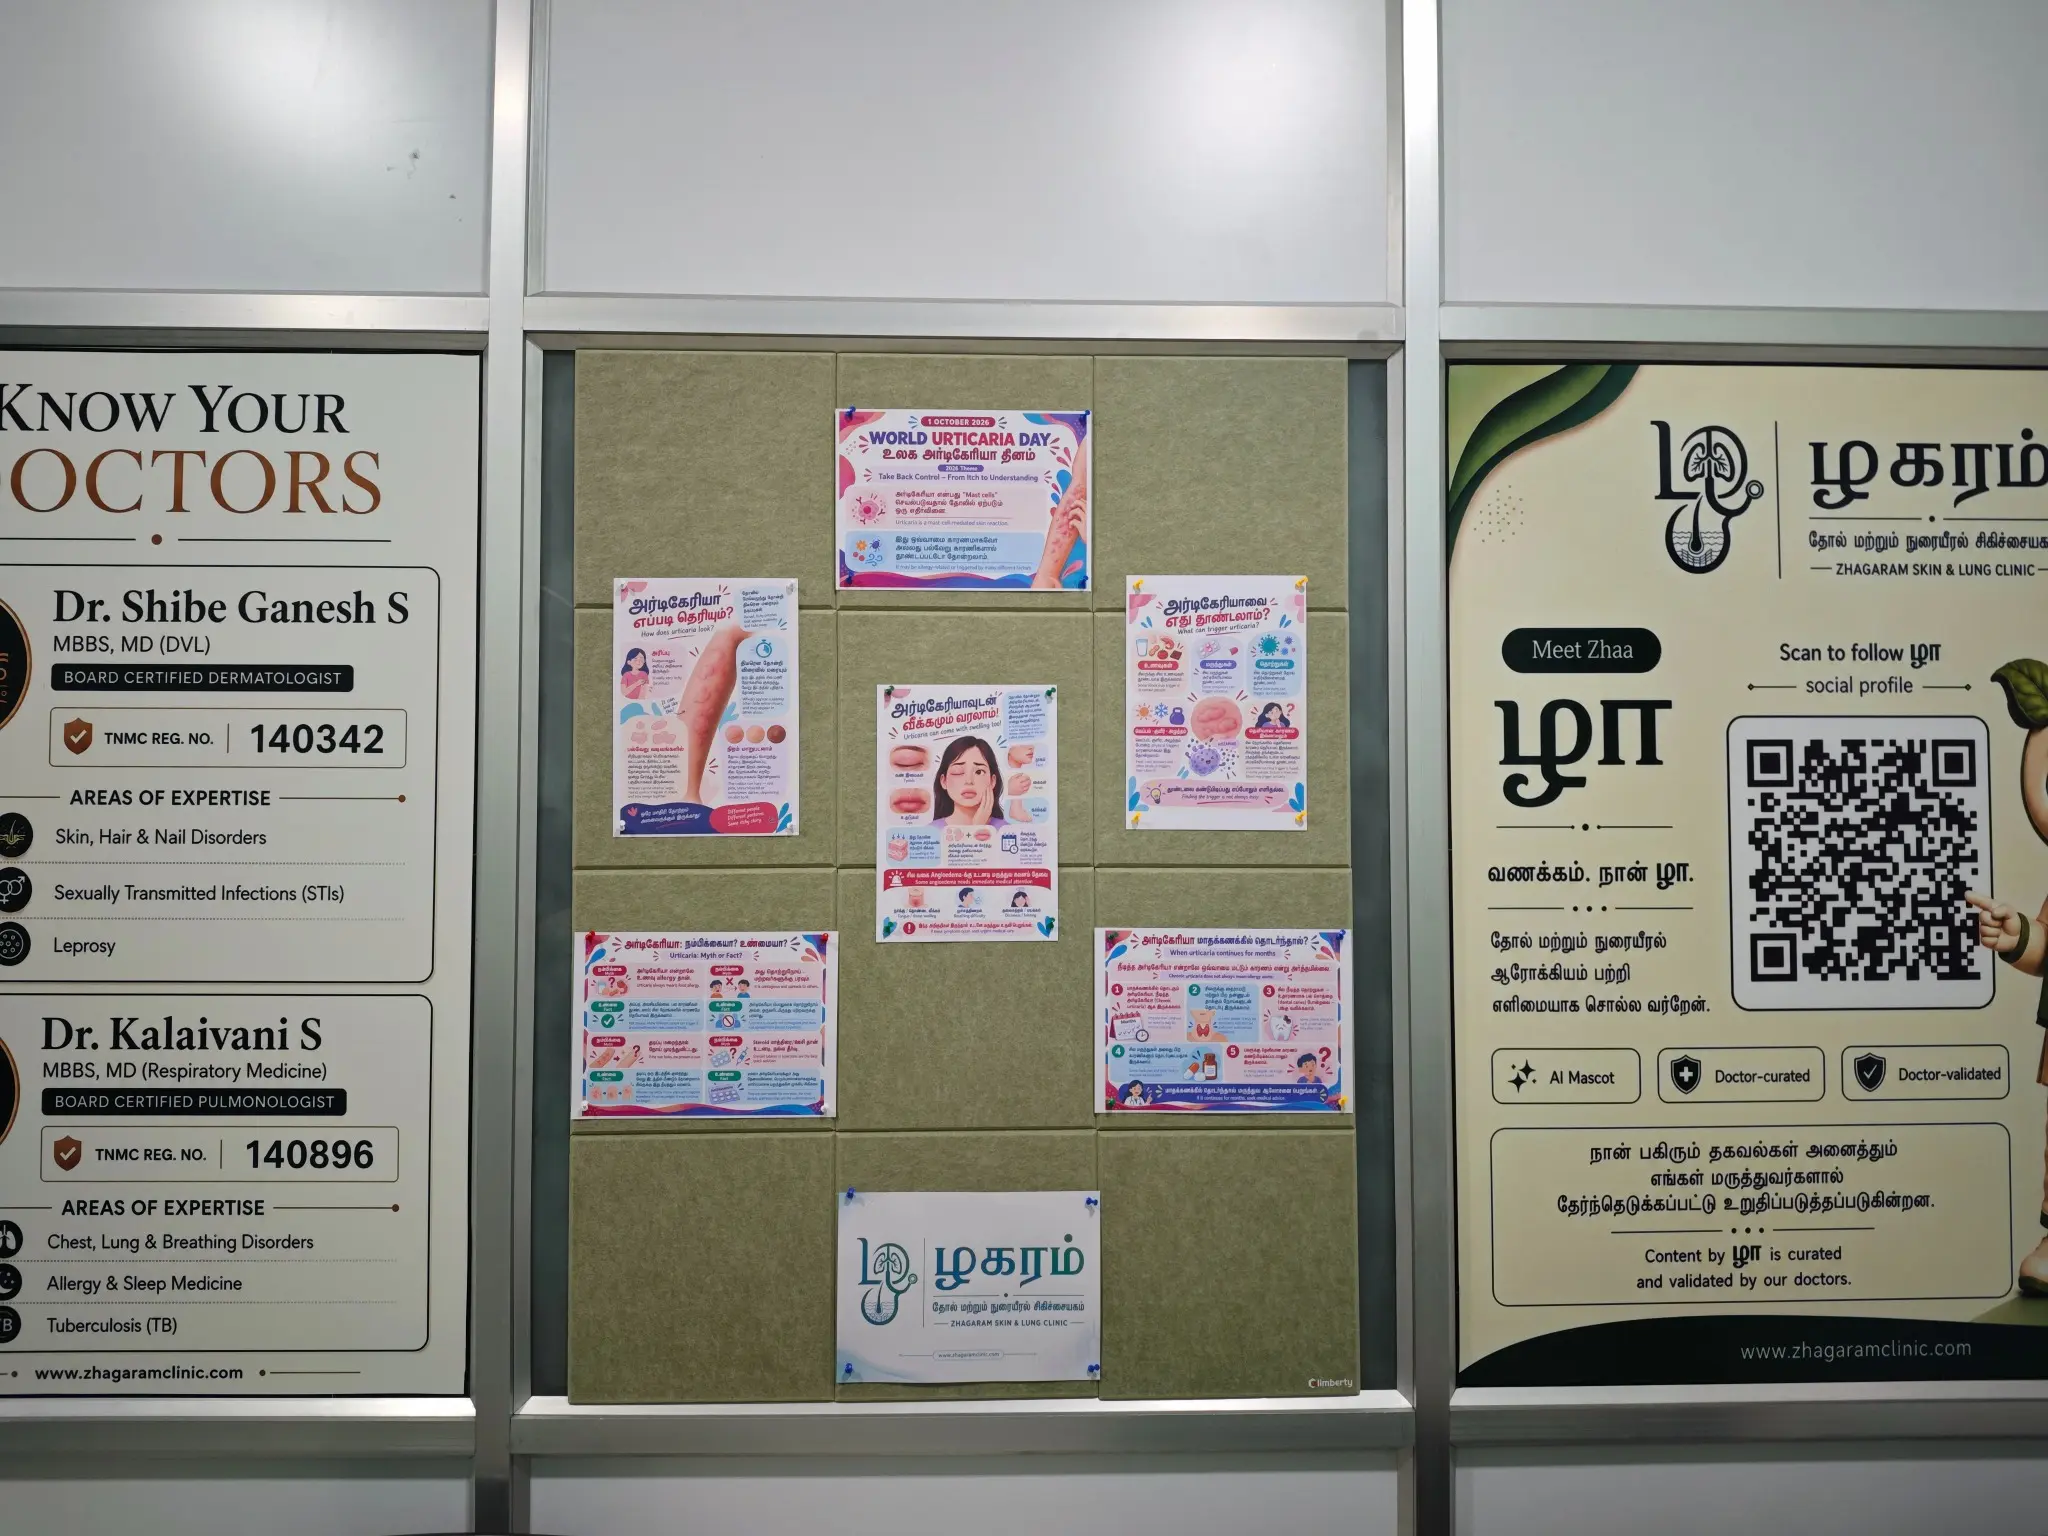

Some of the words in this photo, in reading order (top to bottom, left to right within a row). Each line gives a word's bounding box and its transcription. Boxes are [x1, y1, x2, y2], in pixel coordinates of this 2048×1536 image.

[0, 383, 177, 433] KNOW
[187, 384, 350, 434] YOUR
[934, 418, 970, 426] OCTOBER
[869, 431, 928, 446] WORLD
[932, 431, 1016, 446] URTICARIA
[1019, 432, 1051, 446] DAY
[882, 448, 918, 460] உலக
[922, 448, 997, 462] அர்டிகேரியா
[1000, 448, 1036, 464] தினம்
[0, 447, 382, 516] OCTORS
[990, 474, 1038, 482] Understanding
[1808, 530, 1847, 553] தோல்
[1854, 530, 1899, 554] மற்றும்
[1905, 530, 1969, 554] நுரையீரல்
[1975, 531, 2048, 549] சிகிச்சையக
[1836, 563, 1909, 576] ZHAGARAM
[1912, 563, 1942, 576] SKIN
[1945, 563, 1955, 576] &
[1958, 563, 1992, 577] LUNG
[1995, 563, 2035, 577] CLINIC
[52, 589, 111, 623] Dr.
[122, 588, 227, 624] Shibe
[237, 589, 377, 624] Ganesh
[387, 591, 409, 625] S
[628, 592, 722, 614] அர்டிகேரியா
[1163, 595, 1268, 616] அர்டிகேரியாவை
[633, 612, 674, 628] எப்படி
[677, 606, 734, 625] தெரியும்?
[1165, 614, 1192, 628] எது
[1195, 608, 1270, 627] தூண்டலாம்?
[53, 635, 115, 655] MBBS,
[121, 635, 154, 653] MD
[159, 635, 211, 656] (DVL)
[1532, 639, 1582, 659] Meet
[1587, 639, 1634, 659] Zhaa
[1779, 642, 1822, 662] Scan
[1826, 644, 1846, 662] to
[1850, 642, 1904, 662] follow
[1910, 643, 1942, 670] ழா
[64, 670, 119, 684] BOARD
[123, 671, 204, 684] CERTIFIED
[208, 671, 342, 685] DERMATOLOGIST
[1806, 675, 1853, 694] social
[1859, 675, 1914, 698] profile
[891, 694, 997, 718] அர்டிகேரியாவுடன்
[902, 712, 954, 732] வீக்கமும்
[956, 708, 1000, 724] வரலாம்!
[104, 732, 148, 745] TNMC
[151, 732, 185, 745] REG.
[188, 732, 214, 745] NO.
[250, 723, 384, 754] 140342
[1493, 698, 1673, 808] ழா
[69, 789, 133, 806] AREAS
[138, 789, 166, 806] OF
[171, 789, 271, 806] EXPERTISE
[55, 828, 94, 847] Skin,
[99, 828, 133, 845] Hair
[136, 828, 150, 845] &
[155, 828, 186, 845] Nail
[191, 828, 267, 845] Disorders
[1487, 860, 1591, 883] வணக்கம்.
[1598, 859, 1649, 889] நான்
[1656, 862, 1694, 891] ழா.
[54, 884, 121, 905] Sexually
[124, 884, 216, 901] Transmitted
[221, 884, 297, 901] Infections
[301, 884, 345, 904] (STIs)
[53, 936, 116, 958] Leprosy
[624, 938, 683, 951] அர்டிகேரியா:
[684, 938, 738, 950] நம்பிக்கையா?
[740, 938, 788, 948] உண்மையா?
[1142, 934, 1195, 947] அர்டிகேரியா
[1197, 934, 1254, 946] மாதக்கணக்கில்
[1255, 936, 1309, 948] தொடர்ந்தால்?
[1490, 930, 1533, 953] தோல்
[1538, 931, 1588, 954] மற்றும்
[1594, 930, 1667, 954] நுரையீரல்
[700, 952, 717, 960] Myth
[1490, 962, 1588, 986] ஆரோக்கியம்
[1594, 962, 1631, 985] பற்றி
[1492, 994, 1580, 1013] எளிமையாக
[1585, 994, 1642, 1013] சொல்ல
[1647, 994, 1711, 1017] வர்றேன்.
[40, 1017, 99, 1051] Dr.
[109, 1015, 290, 1051] Kalaivani
[300, 1017, 322, 1051] S
[43, 1061, 100, 1081] MBBS,
[106, 1062, 137, 1079] MD
[141, 1061, 242, 1083] (Respiratory
[246, 1062, 327, 1082] Medicine)
[1549, 1070, 1564, 1085] AI
[1568, 1070, 1615, 1085] Mascot
[1715, 1068, 1811, 1084] Doctor-curated
[1898, 1066, 2002, 1082] Doctor-validated
[1589, 1141, 1632, 1165] நான்
[1639, 1141, 1701, 1164] பகிரும்
[1708, 1139, 1799, 1164] தகவல்கள்
[1805, 1138, 1898, 1163] அனைத்தும்
[1650, 1168, 1705, 1187] எங்கள்
[1711, 1166, 1844, 1191] மருத்துவர்களால்
[1557, 1193, 1717, 1218] தேர்ந்தெடுக்கப்பட்டு
[1723, 1189, 1935, 1217] உறுதிப்படுத்தப்படுகின்றன.
[47, 1233, 96, 1252] Chest,
[101, 1233, 140, 1254] Lung
[144, 1233, 158, 1250] &
[162, 1233, 237, 1254] Breathing
[242, 1233, 314, 1250] Disorders
[934, 1233, 1085, 1291] ழகரம்
[46, 1275, 102, 1296] Allergy
[105, 1275, 119, 1291] &
[123, 1275, 167, 1295] Sleep
[171, 1275, 243, 1291] Medicine
[1636, 1273, 1663, 1289] and
[1668, 1272, 1733, 1289] validated
[1739, 1272, 1758, 1291] by
[1763, 1275, 1788, 1287] our
[1793, 1271, 1852, 1287] doctors.
[932, 1301, 958, 1315] தோல்
[960, 1301, 988, 1315] மற்றும்
[990, 1300, 1031, 1315] நுரையீரல்
[1033, 1300, 1085, 1312] சிகிச்சையகம்
[46, 1317, 142, 1334] Tuberculosis
[146, 1317, 178, 1336] (TB)
[950, 1319, 993, 1328] ZHAGARAM
[994, 1319, 1012, 1327] SKIN
[1013, 1319, 1019, 1327] &
[1021, 1319, 1041, 1327] LUNG
[1043, 1319, 1068, 1327] CLINIC
[1740, 1339, 1972, 1363] www.zhagaramclinic.com
[34, 1365, 243, 1384] www.zhagaramclinic.com
